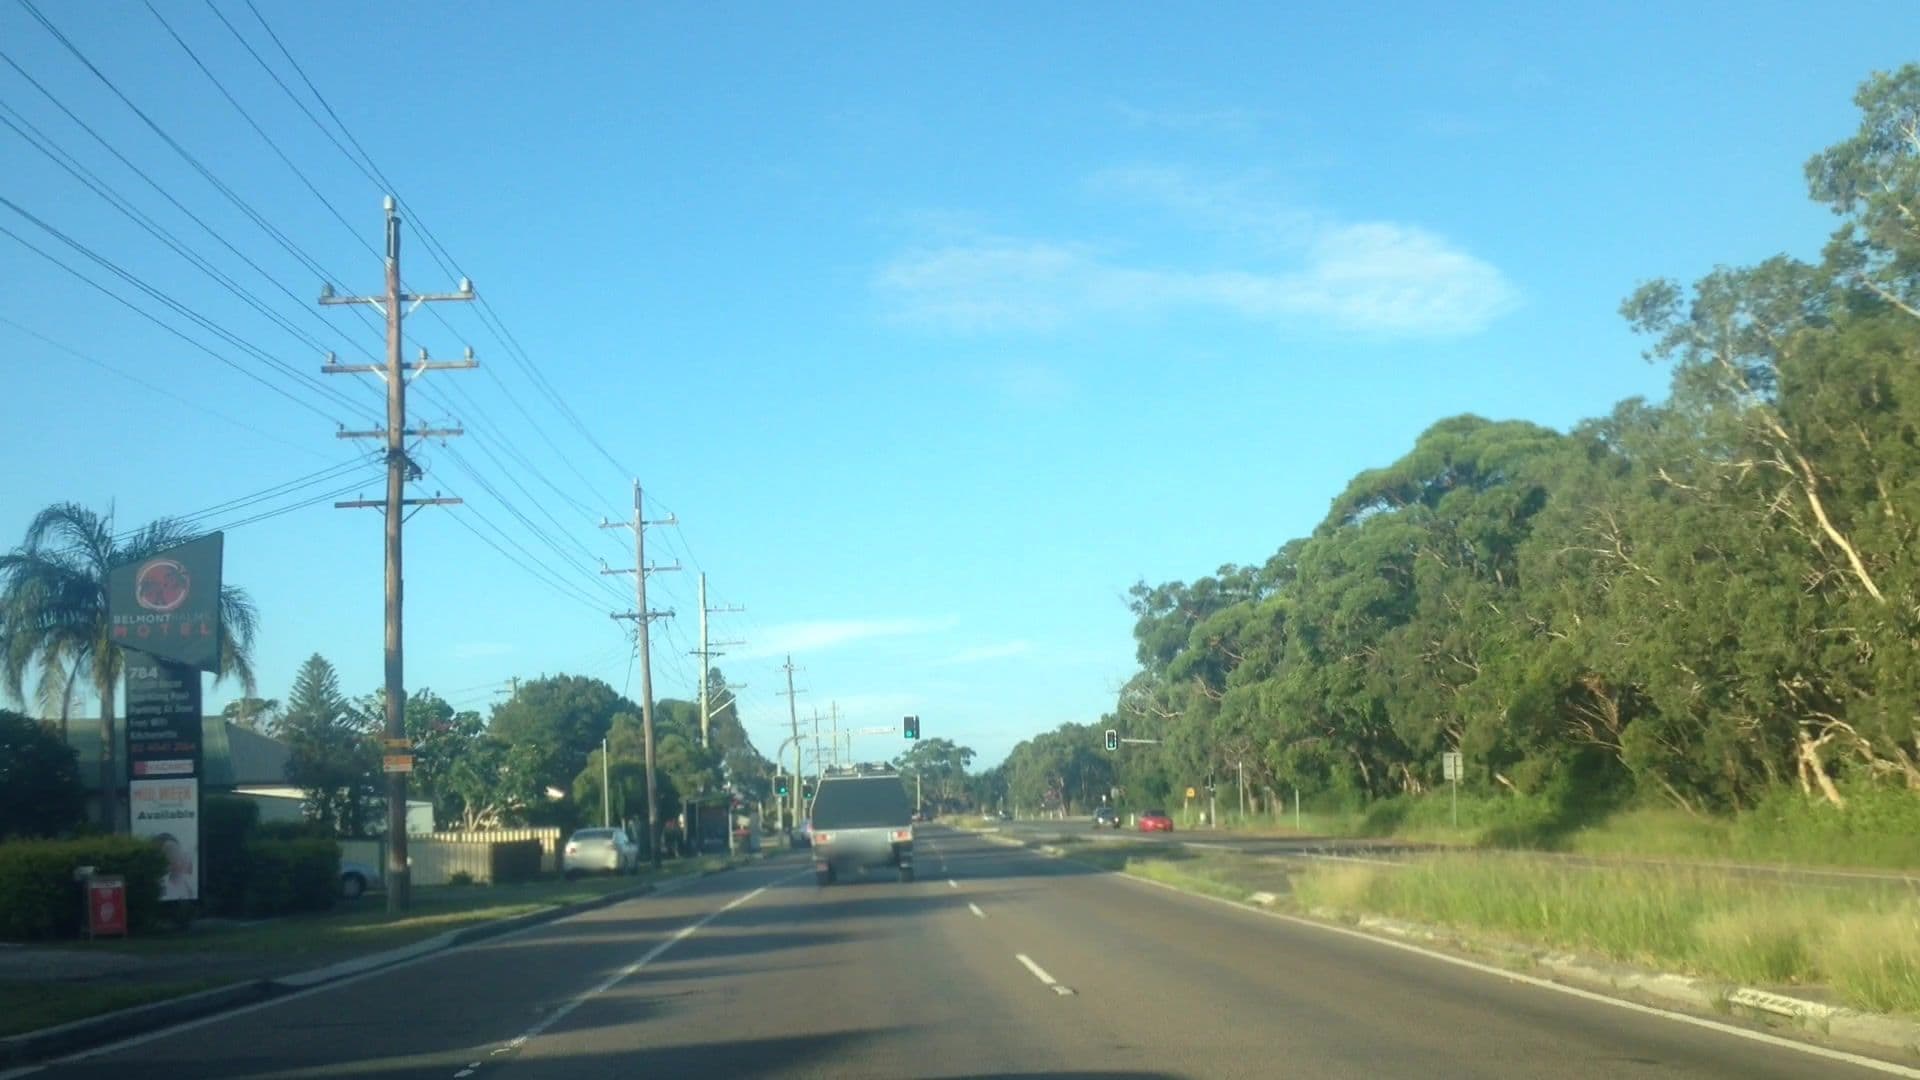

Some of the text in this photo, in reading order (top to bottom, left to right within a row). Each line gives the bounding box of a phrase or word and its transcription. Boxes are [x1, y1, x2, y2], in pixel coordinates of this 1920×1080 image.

[113, 614, 171, 624] BELMONT
[113, 623, 211, 638] MOTEL
[128, 666, 158, 679] 784
[137, 809, 195, 820] Available
